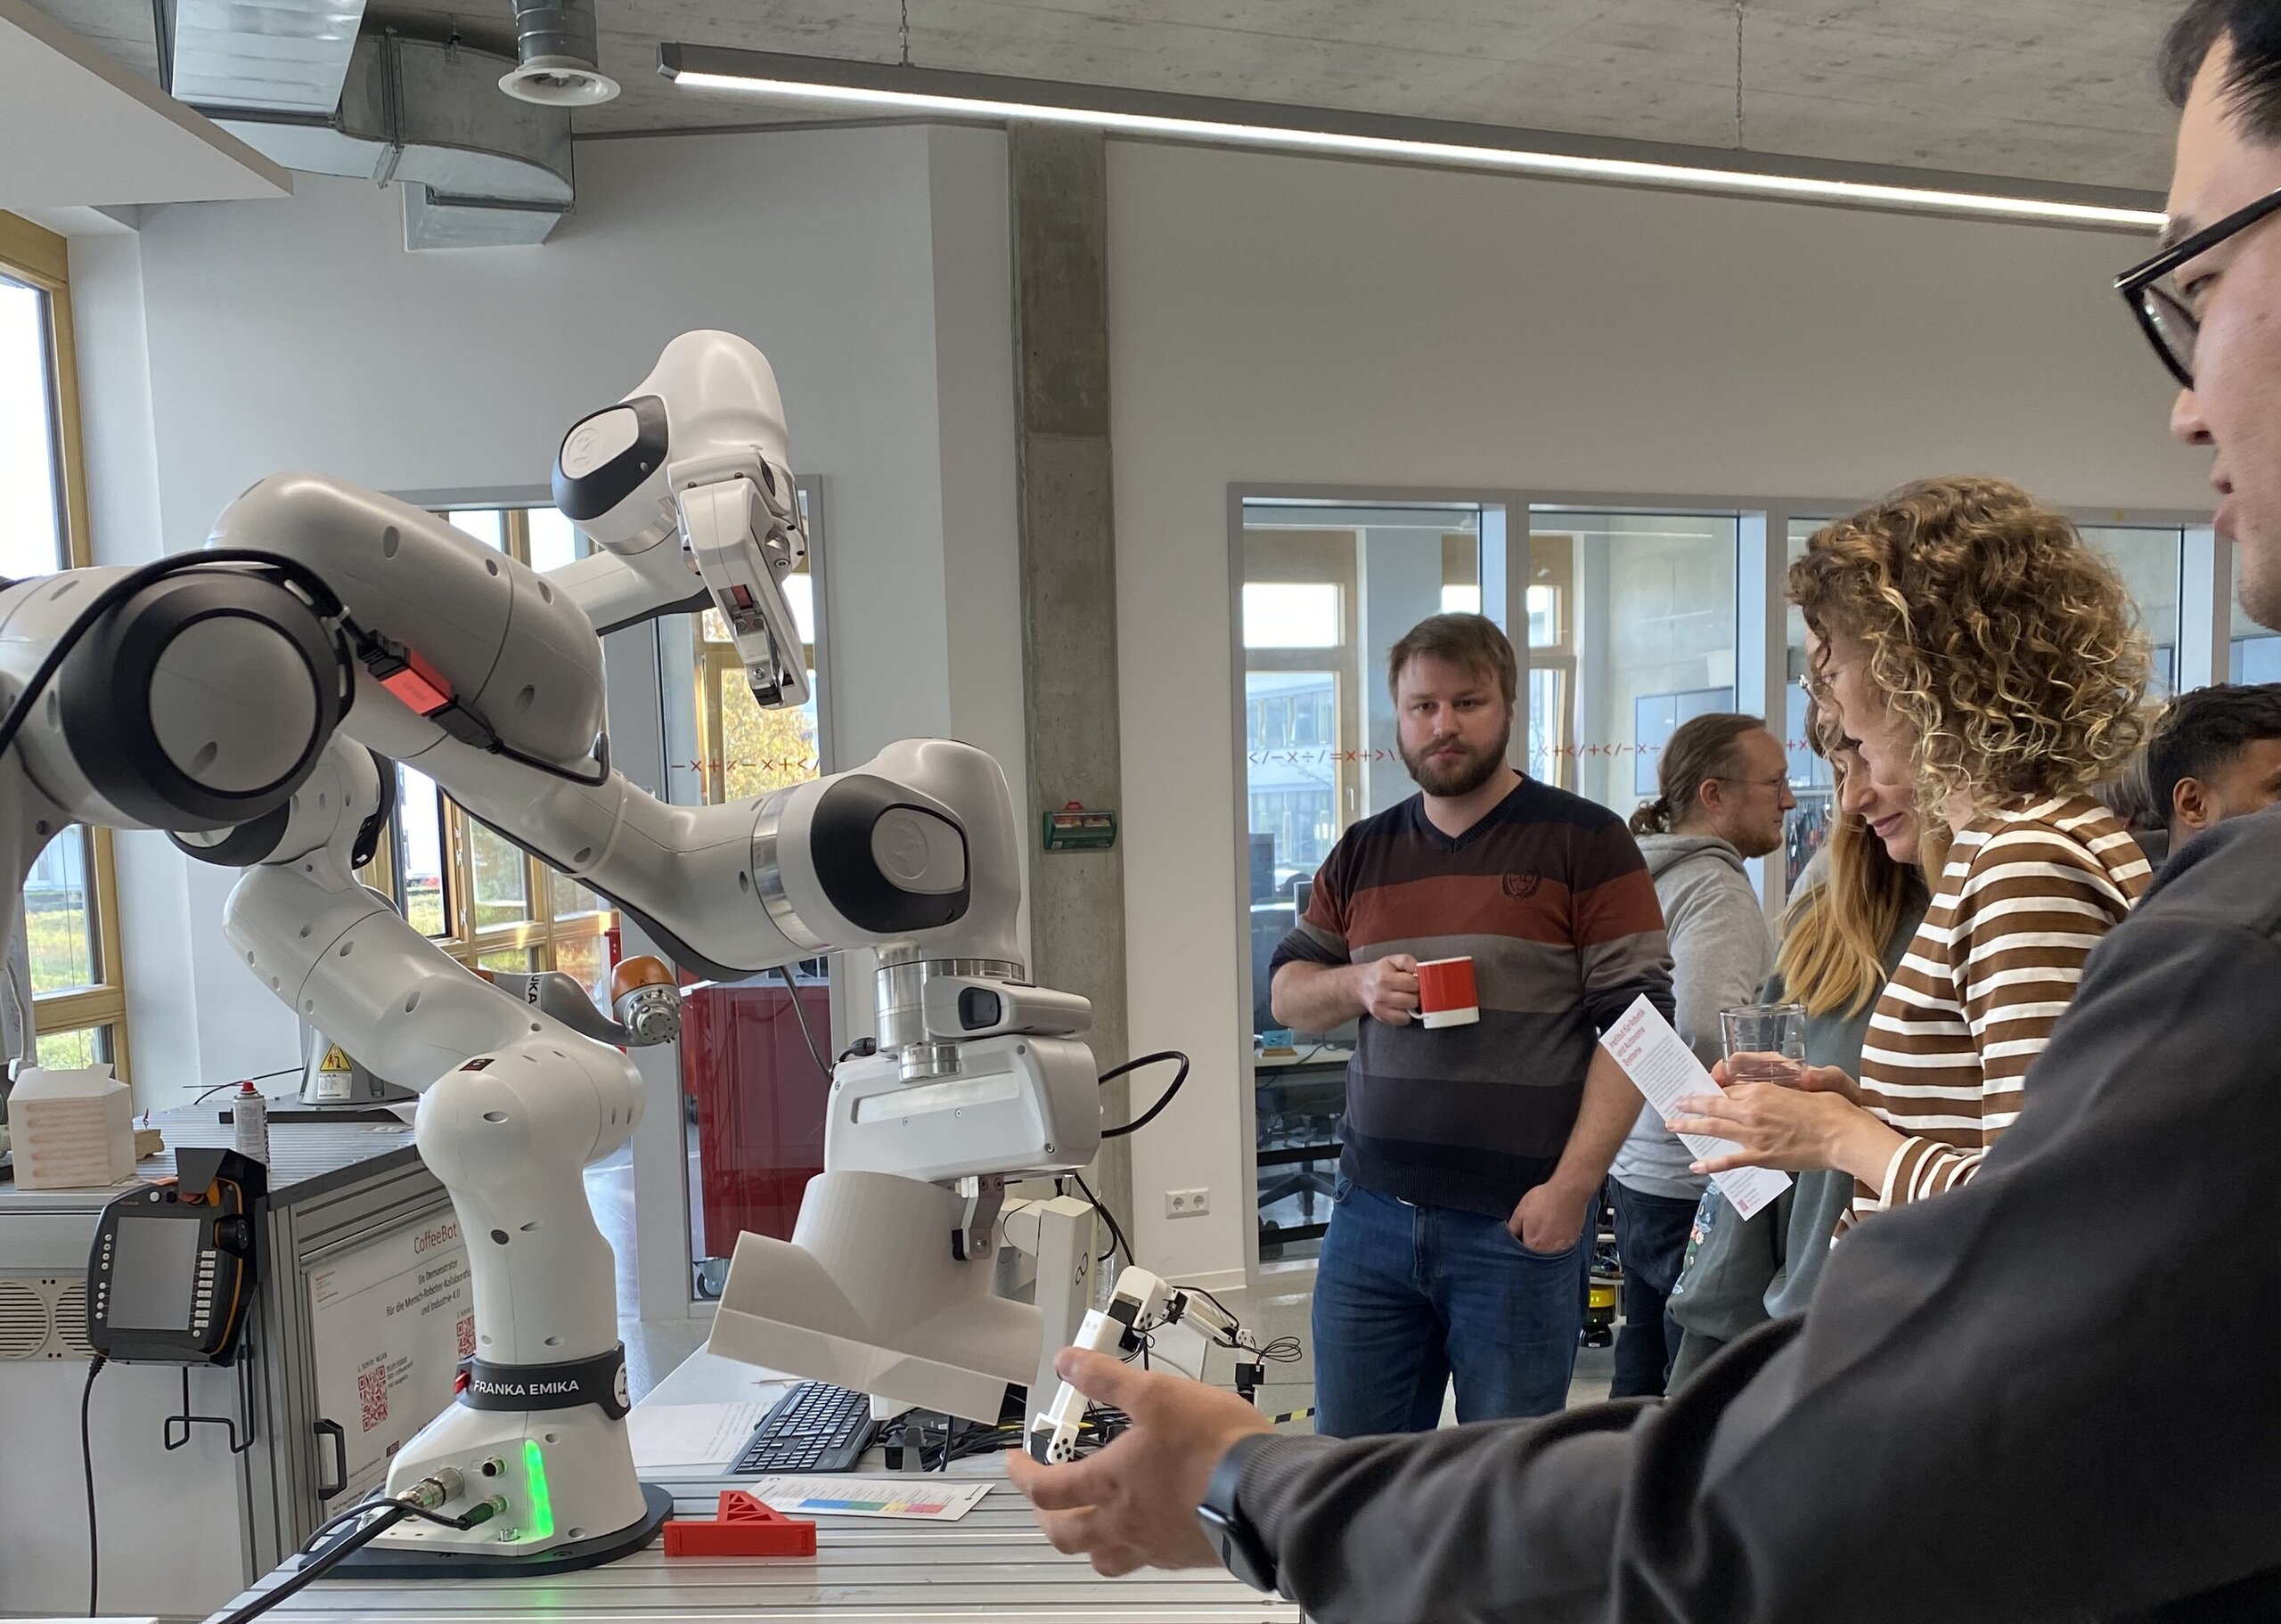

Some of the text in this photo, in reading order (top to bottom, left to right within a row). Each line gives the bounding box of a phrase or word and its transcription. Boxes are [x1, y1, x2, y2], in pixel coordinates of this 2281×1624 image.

[528, 975, 538, 1004] UKA
[413, 1223, 458, 1254] CoffeeBot
[418, 1260, 458, 1285] Ein Demonstrator
[430, 1294, 452, 1310] Industrie
[473, 1379, 579, 1396] FRANKA EMIKA
